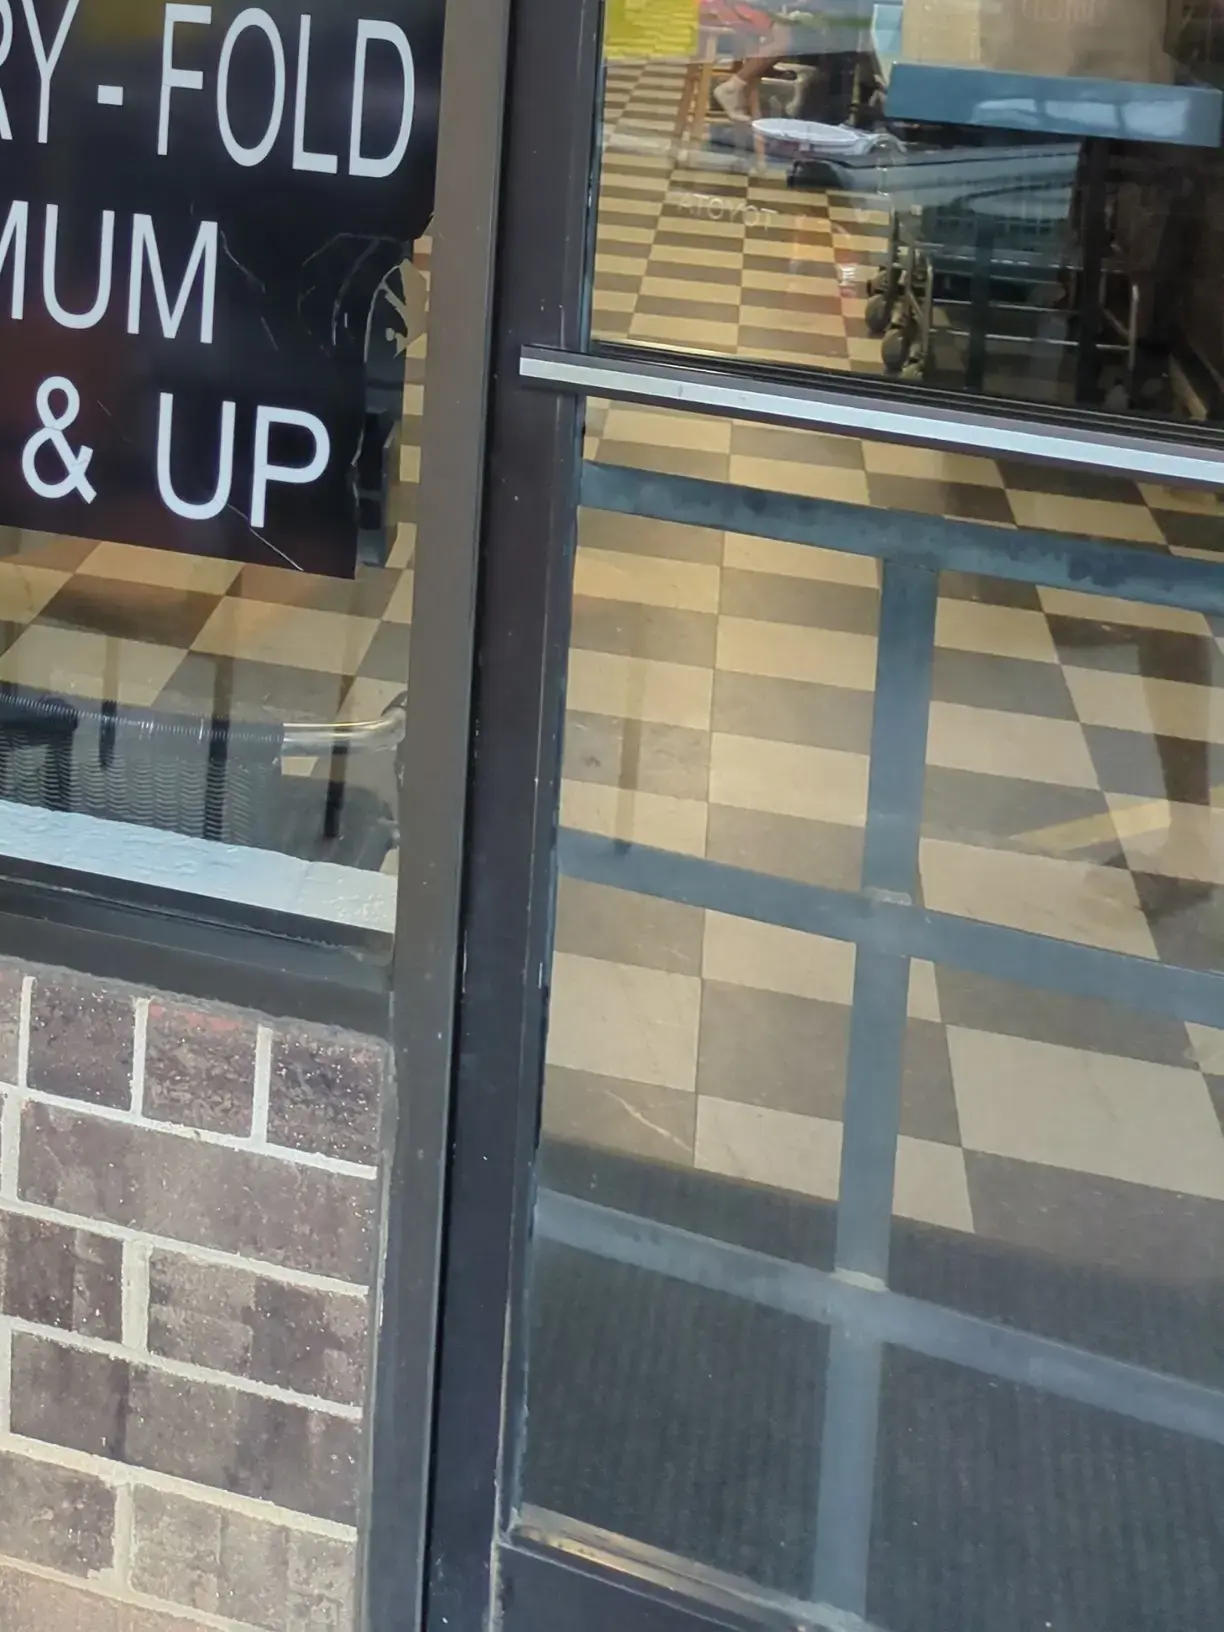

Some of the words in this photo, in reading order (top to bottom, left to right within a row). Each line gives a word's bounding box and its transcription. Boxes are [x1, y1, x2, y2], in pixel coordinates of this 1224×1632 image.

[157, 2, 416, 179] FOLD
[22, 375, 97, 504] &
[156, 392, 331, 529] UP
